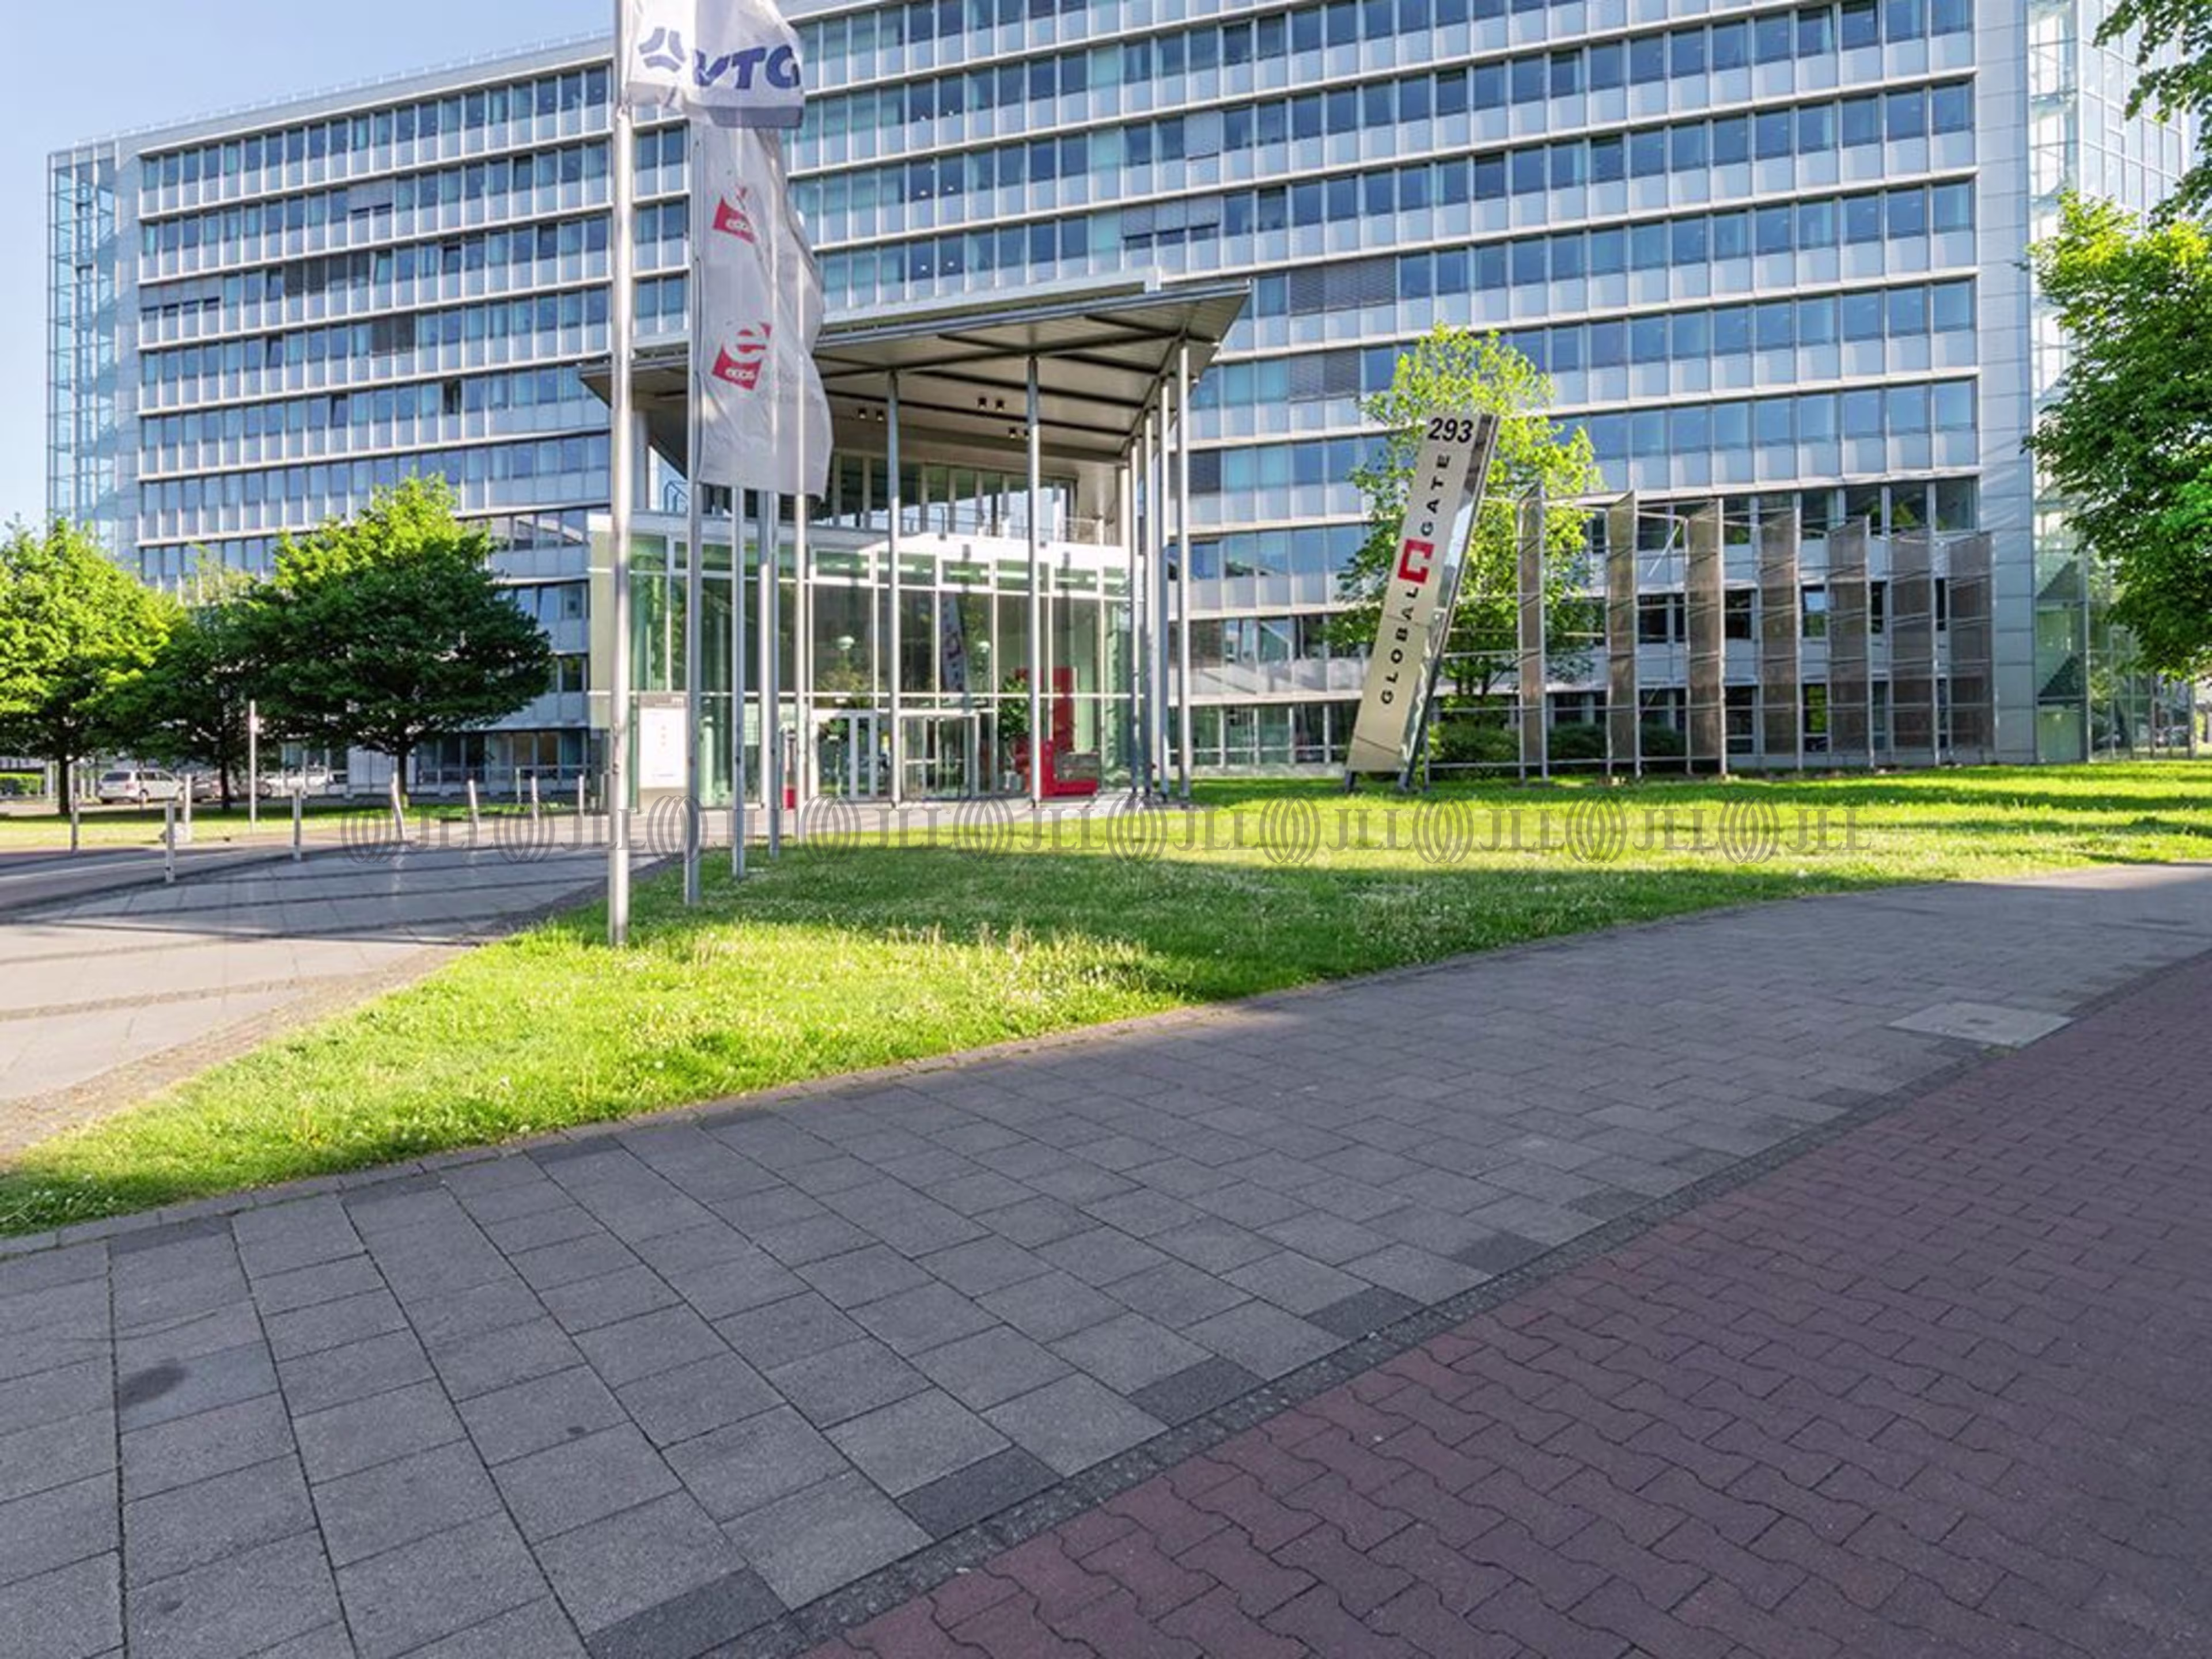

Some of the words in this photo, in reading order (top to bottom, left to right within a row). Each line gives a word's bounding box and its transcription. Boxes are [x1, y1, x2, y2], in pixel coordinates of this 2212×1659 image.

[1427, 417, 1474, 443] 293
[1380, 586, 1419, 704] GLOBAL
[1420, 454, 1451, 536] GATE
